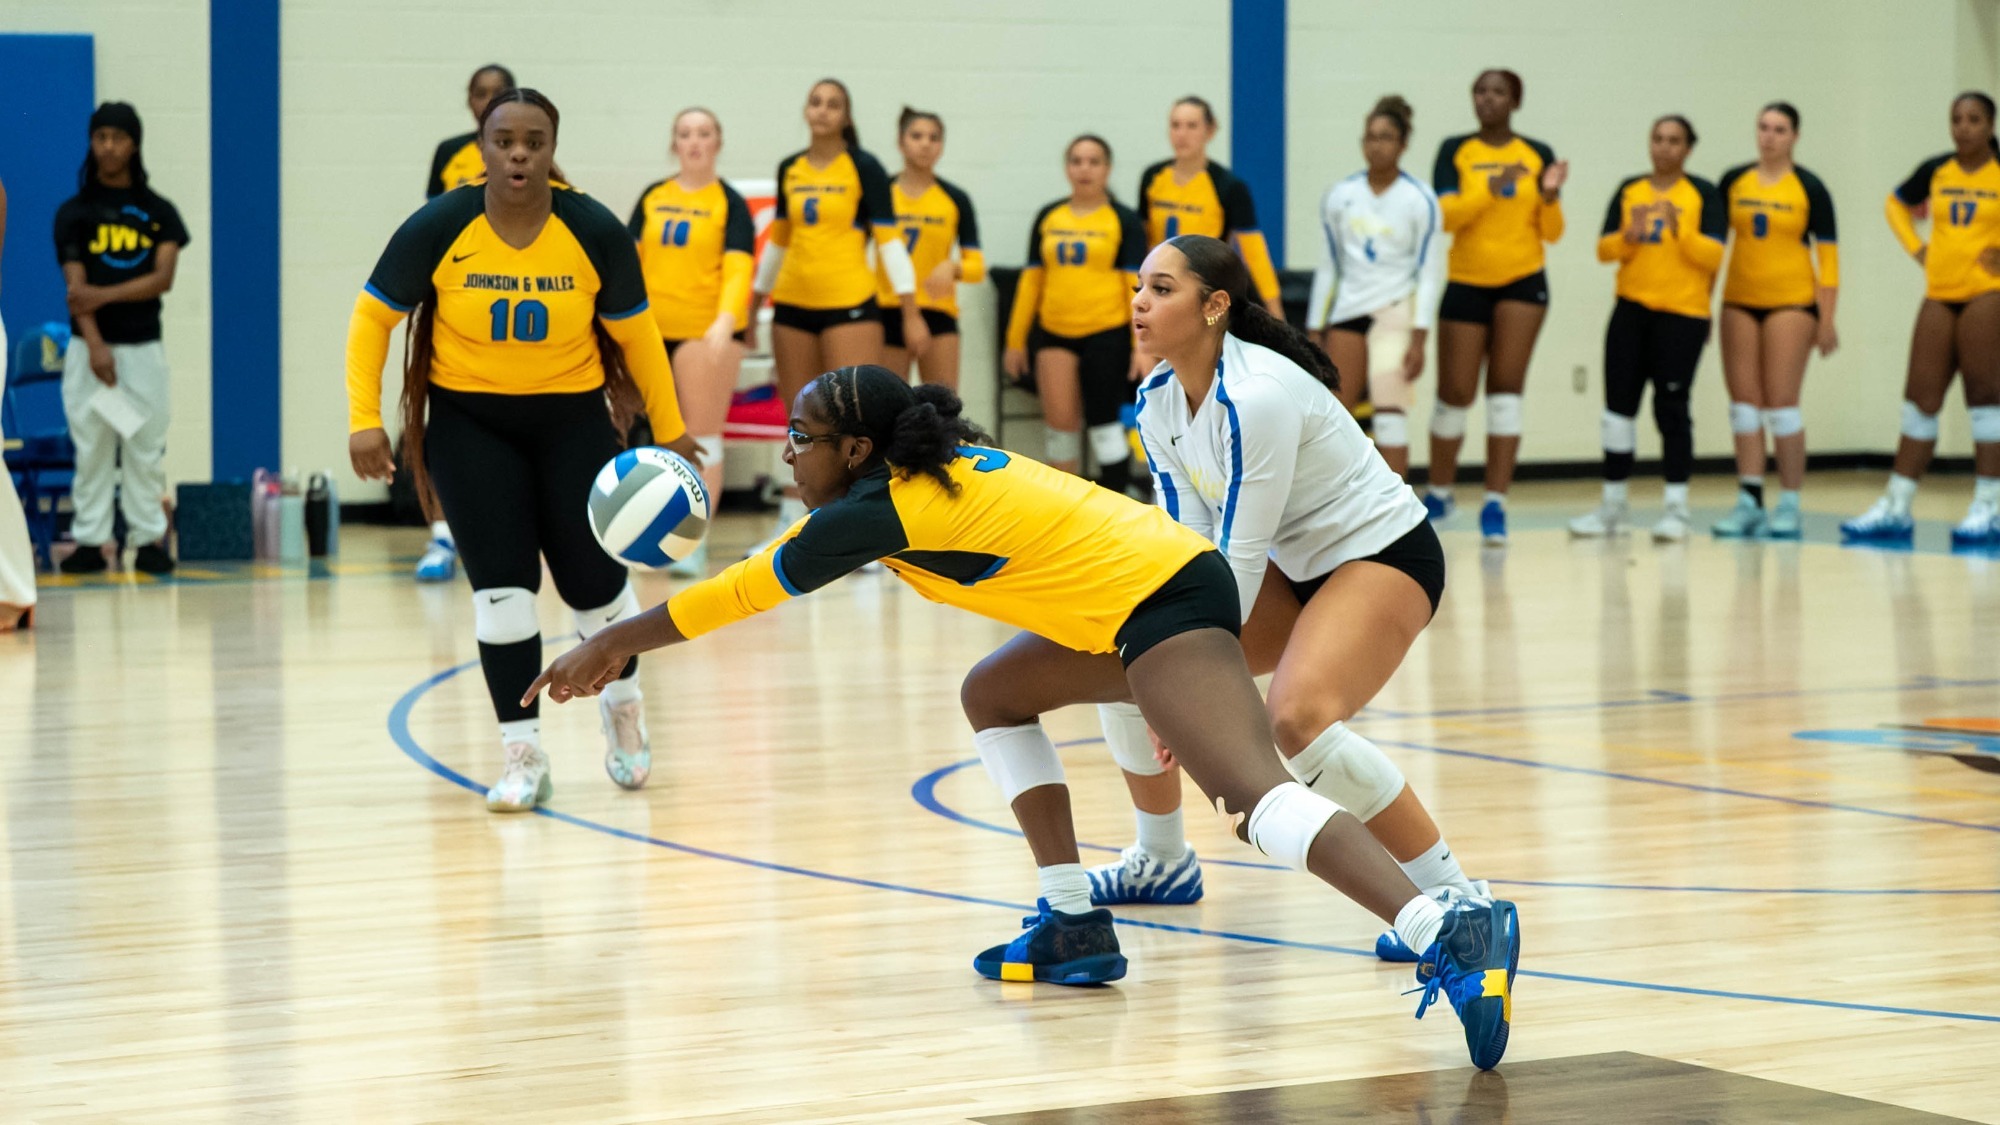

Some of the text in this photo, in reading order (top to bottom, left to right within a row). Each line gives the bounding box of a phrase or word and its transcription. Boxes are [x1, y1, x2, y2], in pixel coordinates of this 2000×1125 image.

[1950, 201, 1977, 226] 17
[661, 219, 691, 247] 10
[463, 273, 575, 292] JOHNSON & WALES
[490, 298, 549, 342] 10
